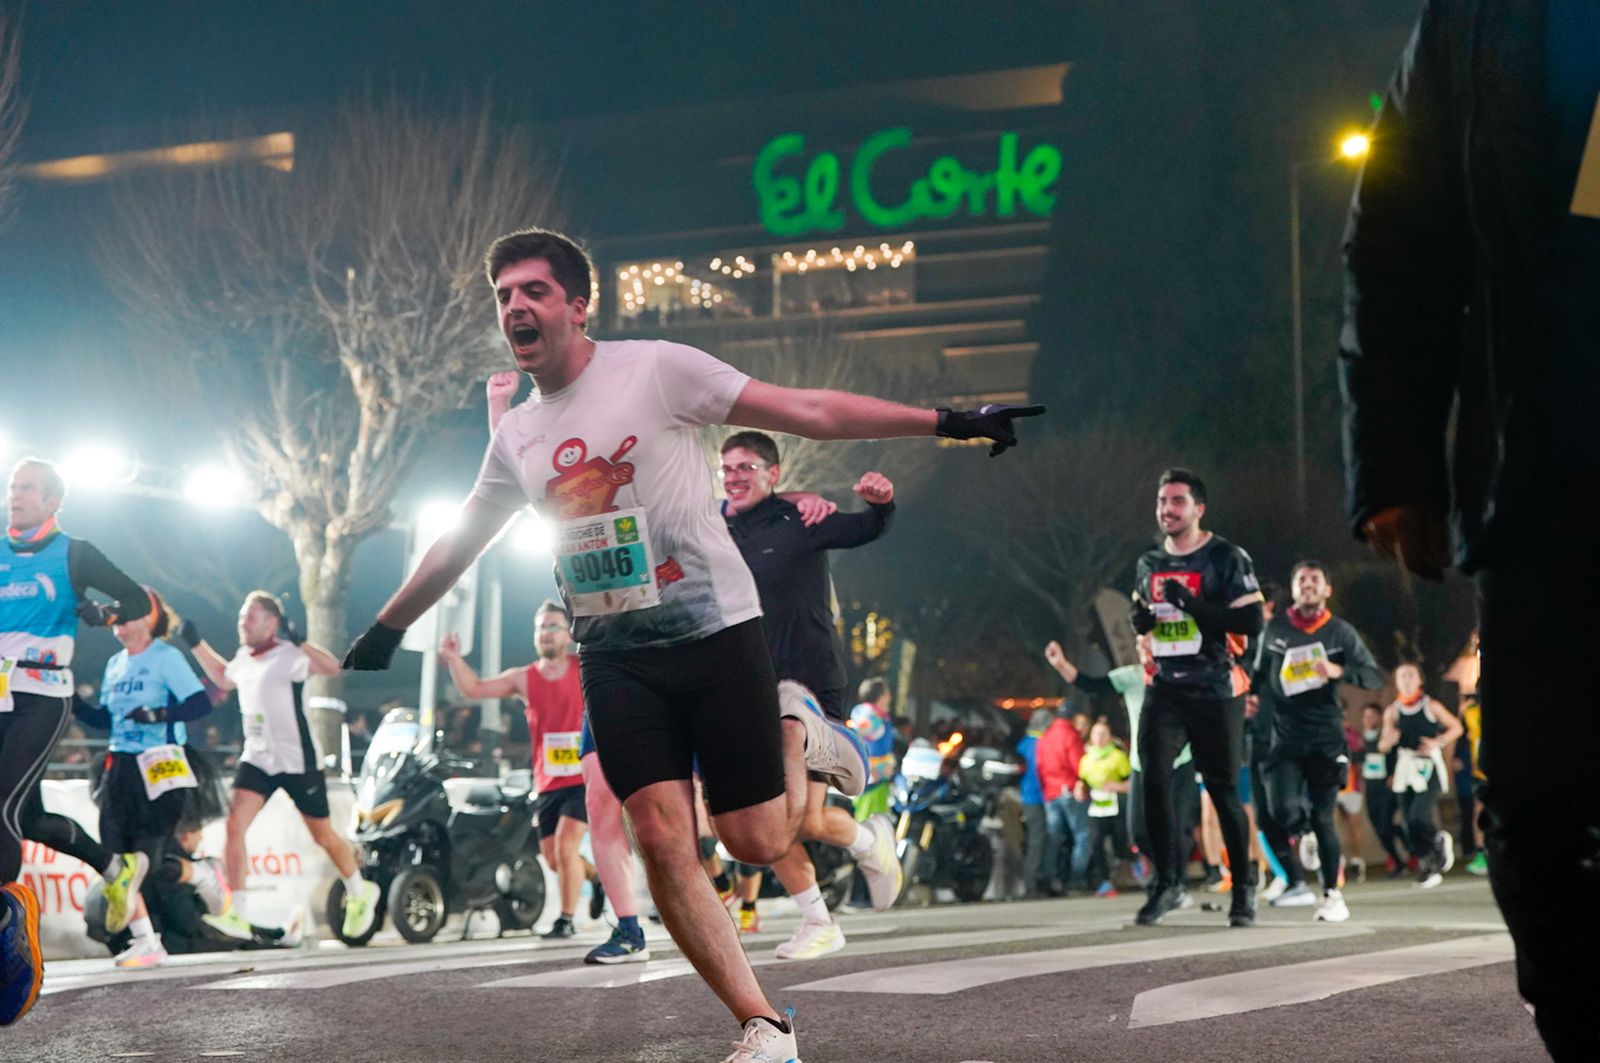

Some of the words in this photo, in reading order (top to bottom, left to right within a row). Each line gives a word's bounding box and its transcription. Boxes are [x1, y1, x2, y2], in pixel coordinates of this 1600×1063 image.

[754, 132, 844, 235] El
[851, 127, 1063, 228] Corte
[571, 547, 633, 583] 9046
